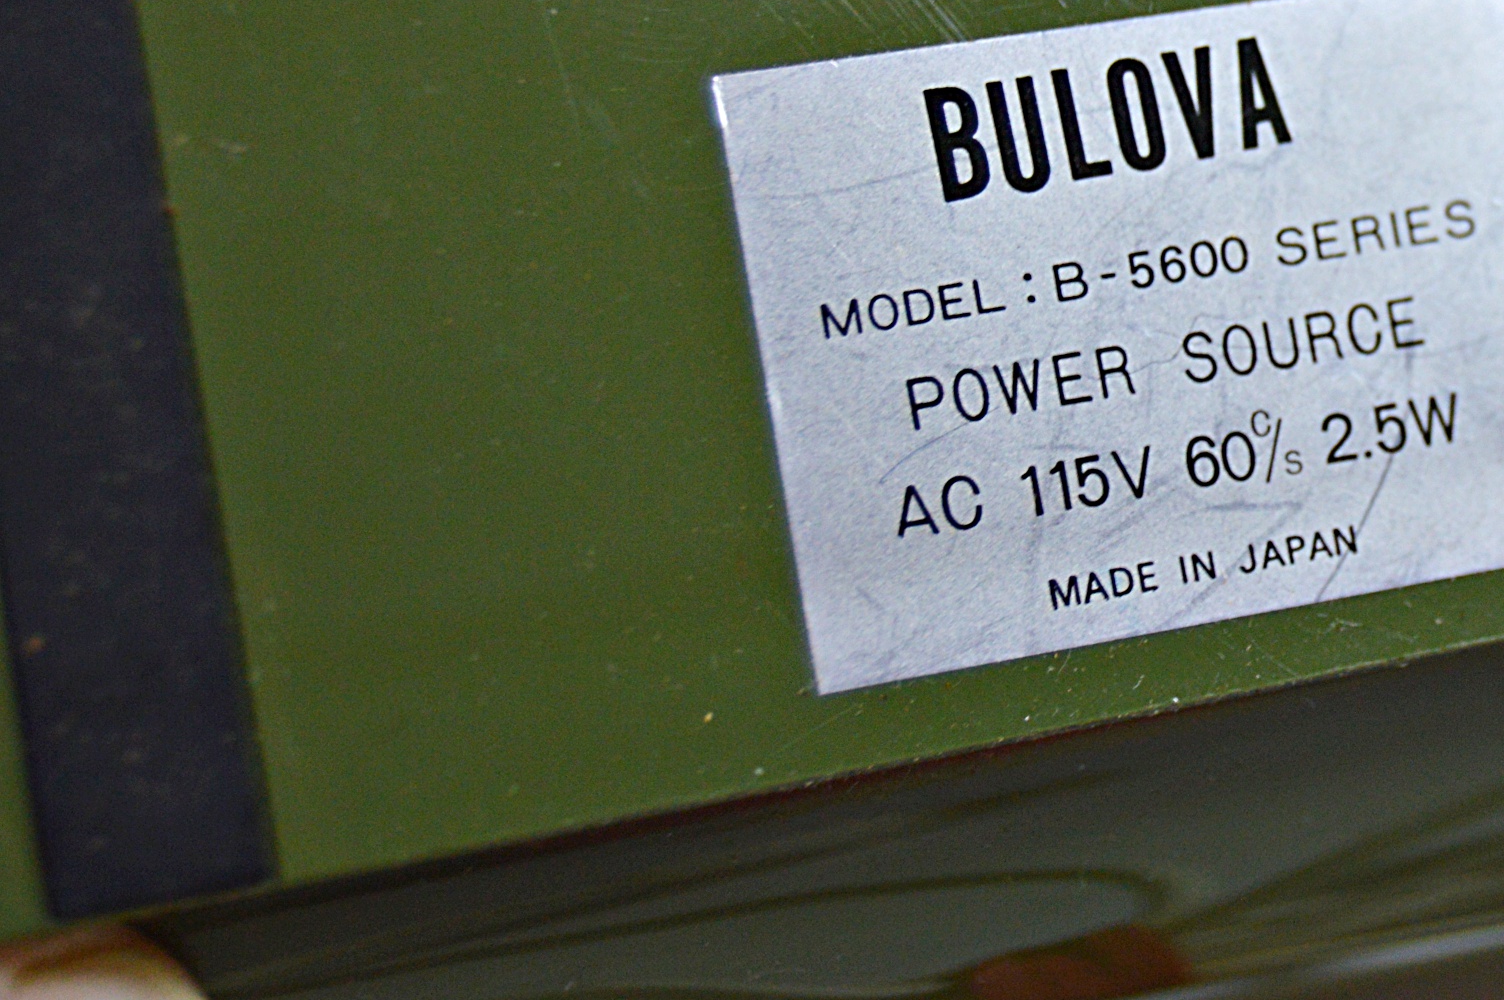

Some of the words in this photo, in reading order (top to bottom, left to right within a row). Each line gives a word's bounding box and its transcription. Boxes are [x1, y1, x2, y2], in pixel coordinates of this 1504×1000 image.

[922, 36, 1292, 203] BULOVA
[1052, 236, 1248, 303] B-5600
[1276, 199, 1477, 266] SERIES
[905, 345, 1137, 431] POWER
[1182, 296, 1426, 384] SOURCE
[897, 475, 984, 538] AC
[1020, 445, 1152, 518] 115V
[1321, 392, 1459, 465] 2.5W
[1048, 561, 1159, 611] MADE
[1178, 551, 1217, 584] IN
[1239, 525, 1359, 574] JAPAN
